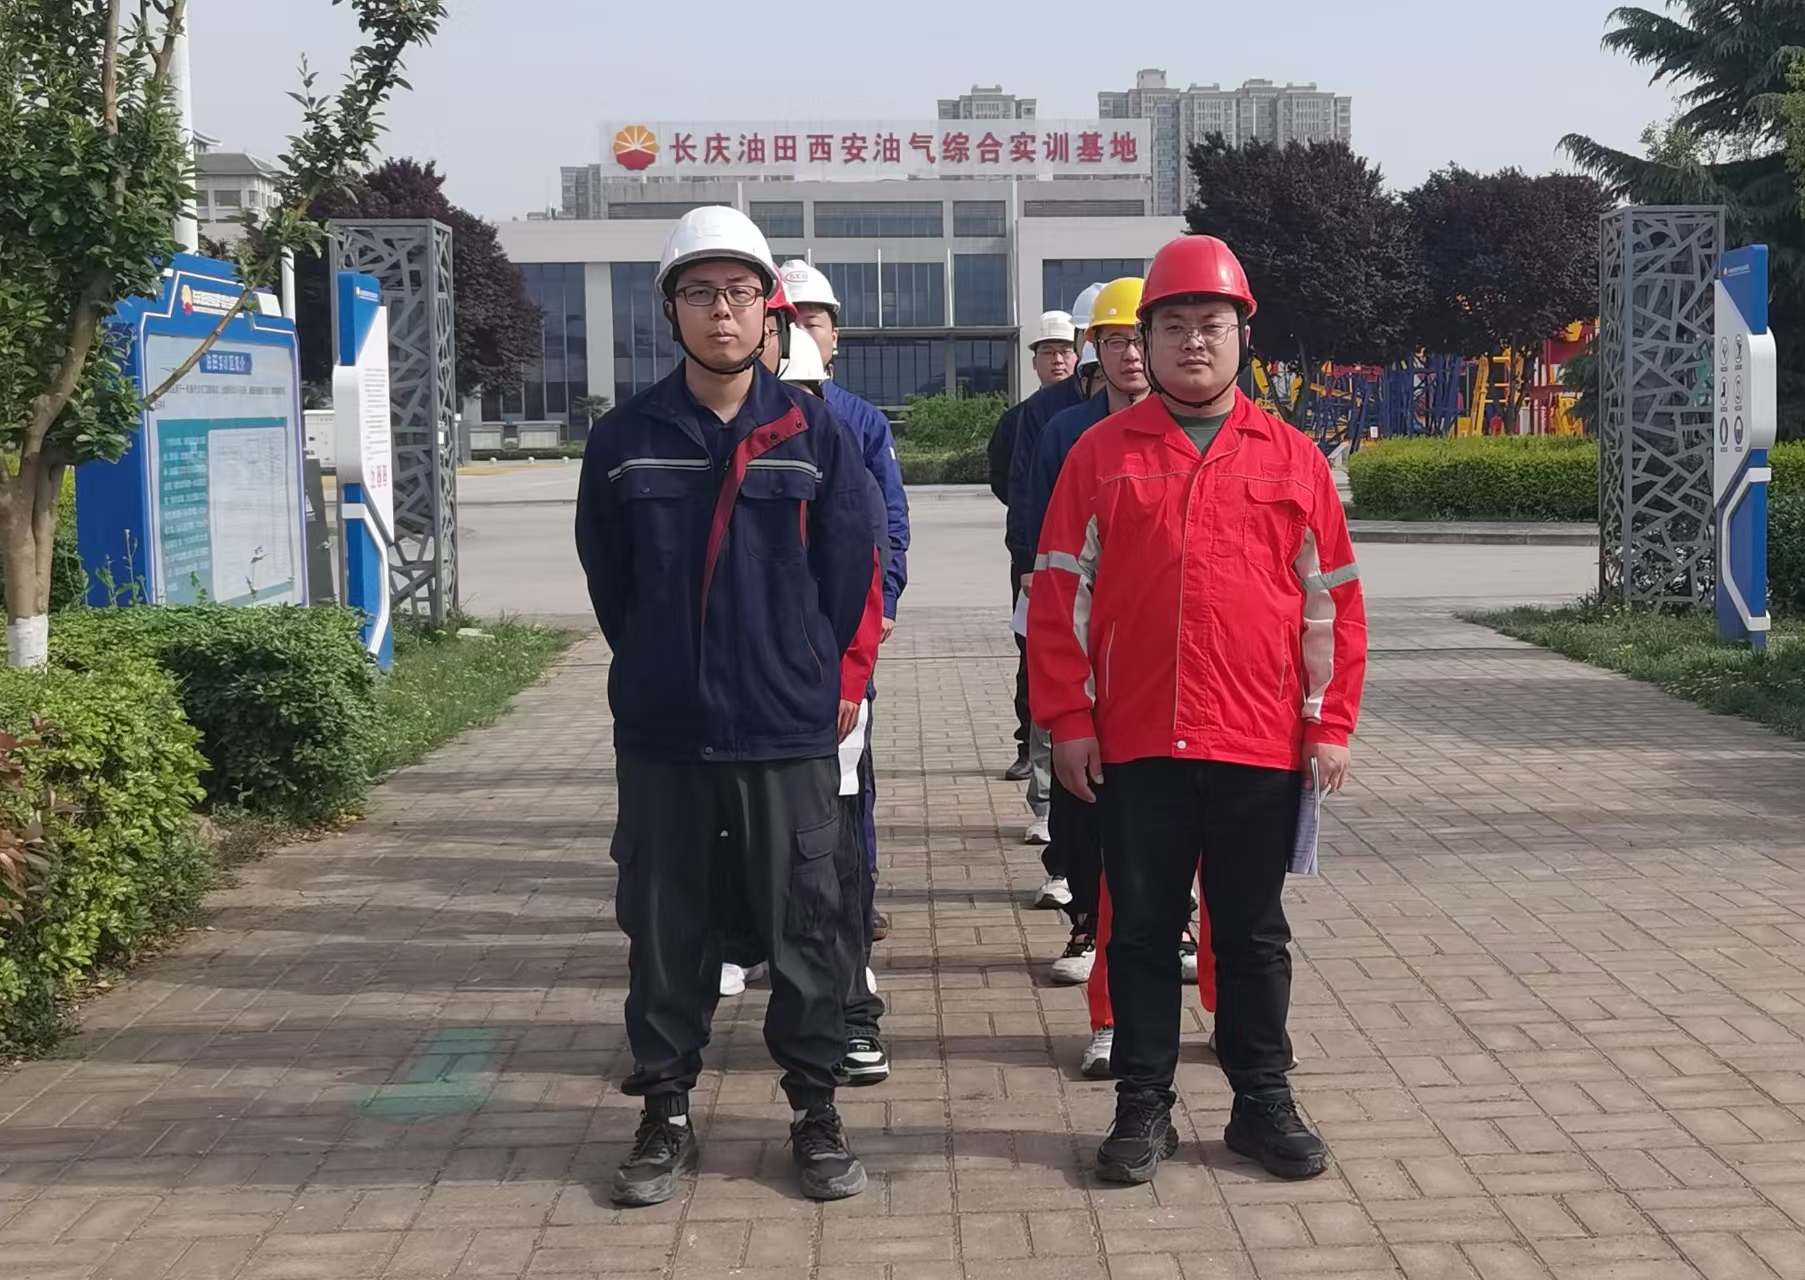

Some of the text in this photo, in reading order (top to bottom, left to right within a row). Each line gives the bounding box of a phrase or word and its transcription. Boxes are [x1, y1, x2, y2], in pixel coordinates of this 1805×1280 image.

[669, 132, 1139, 165] 长庆油田西安油气综合实训基地
